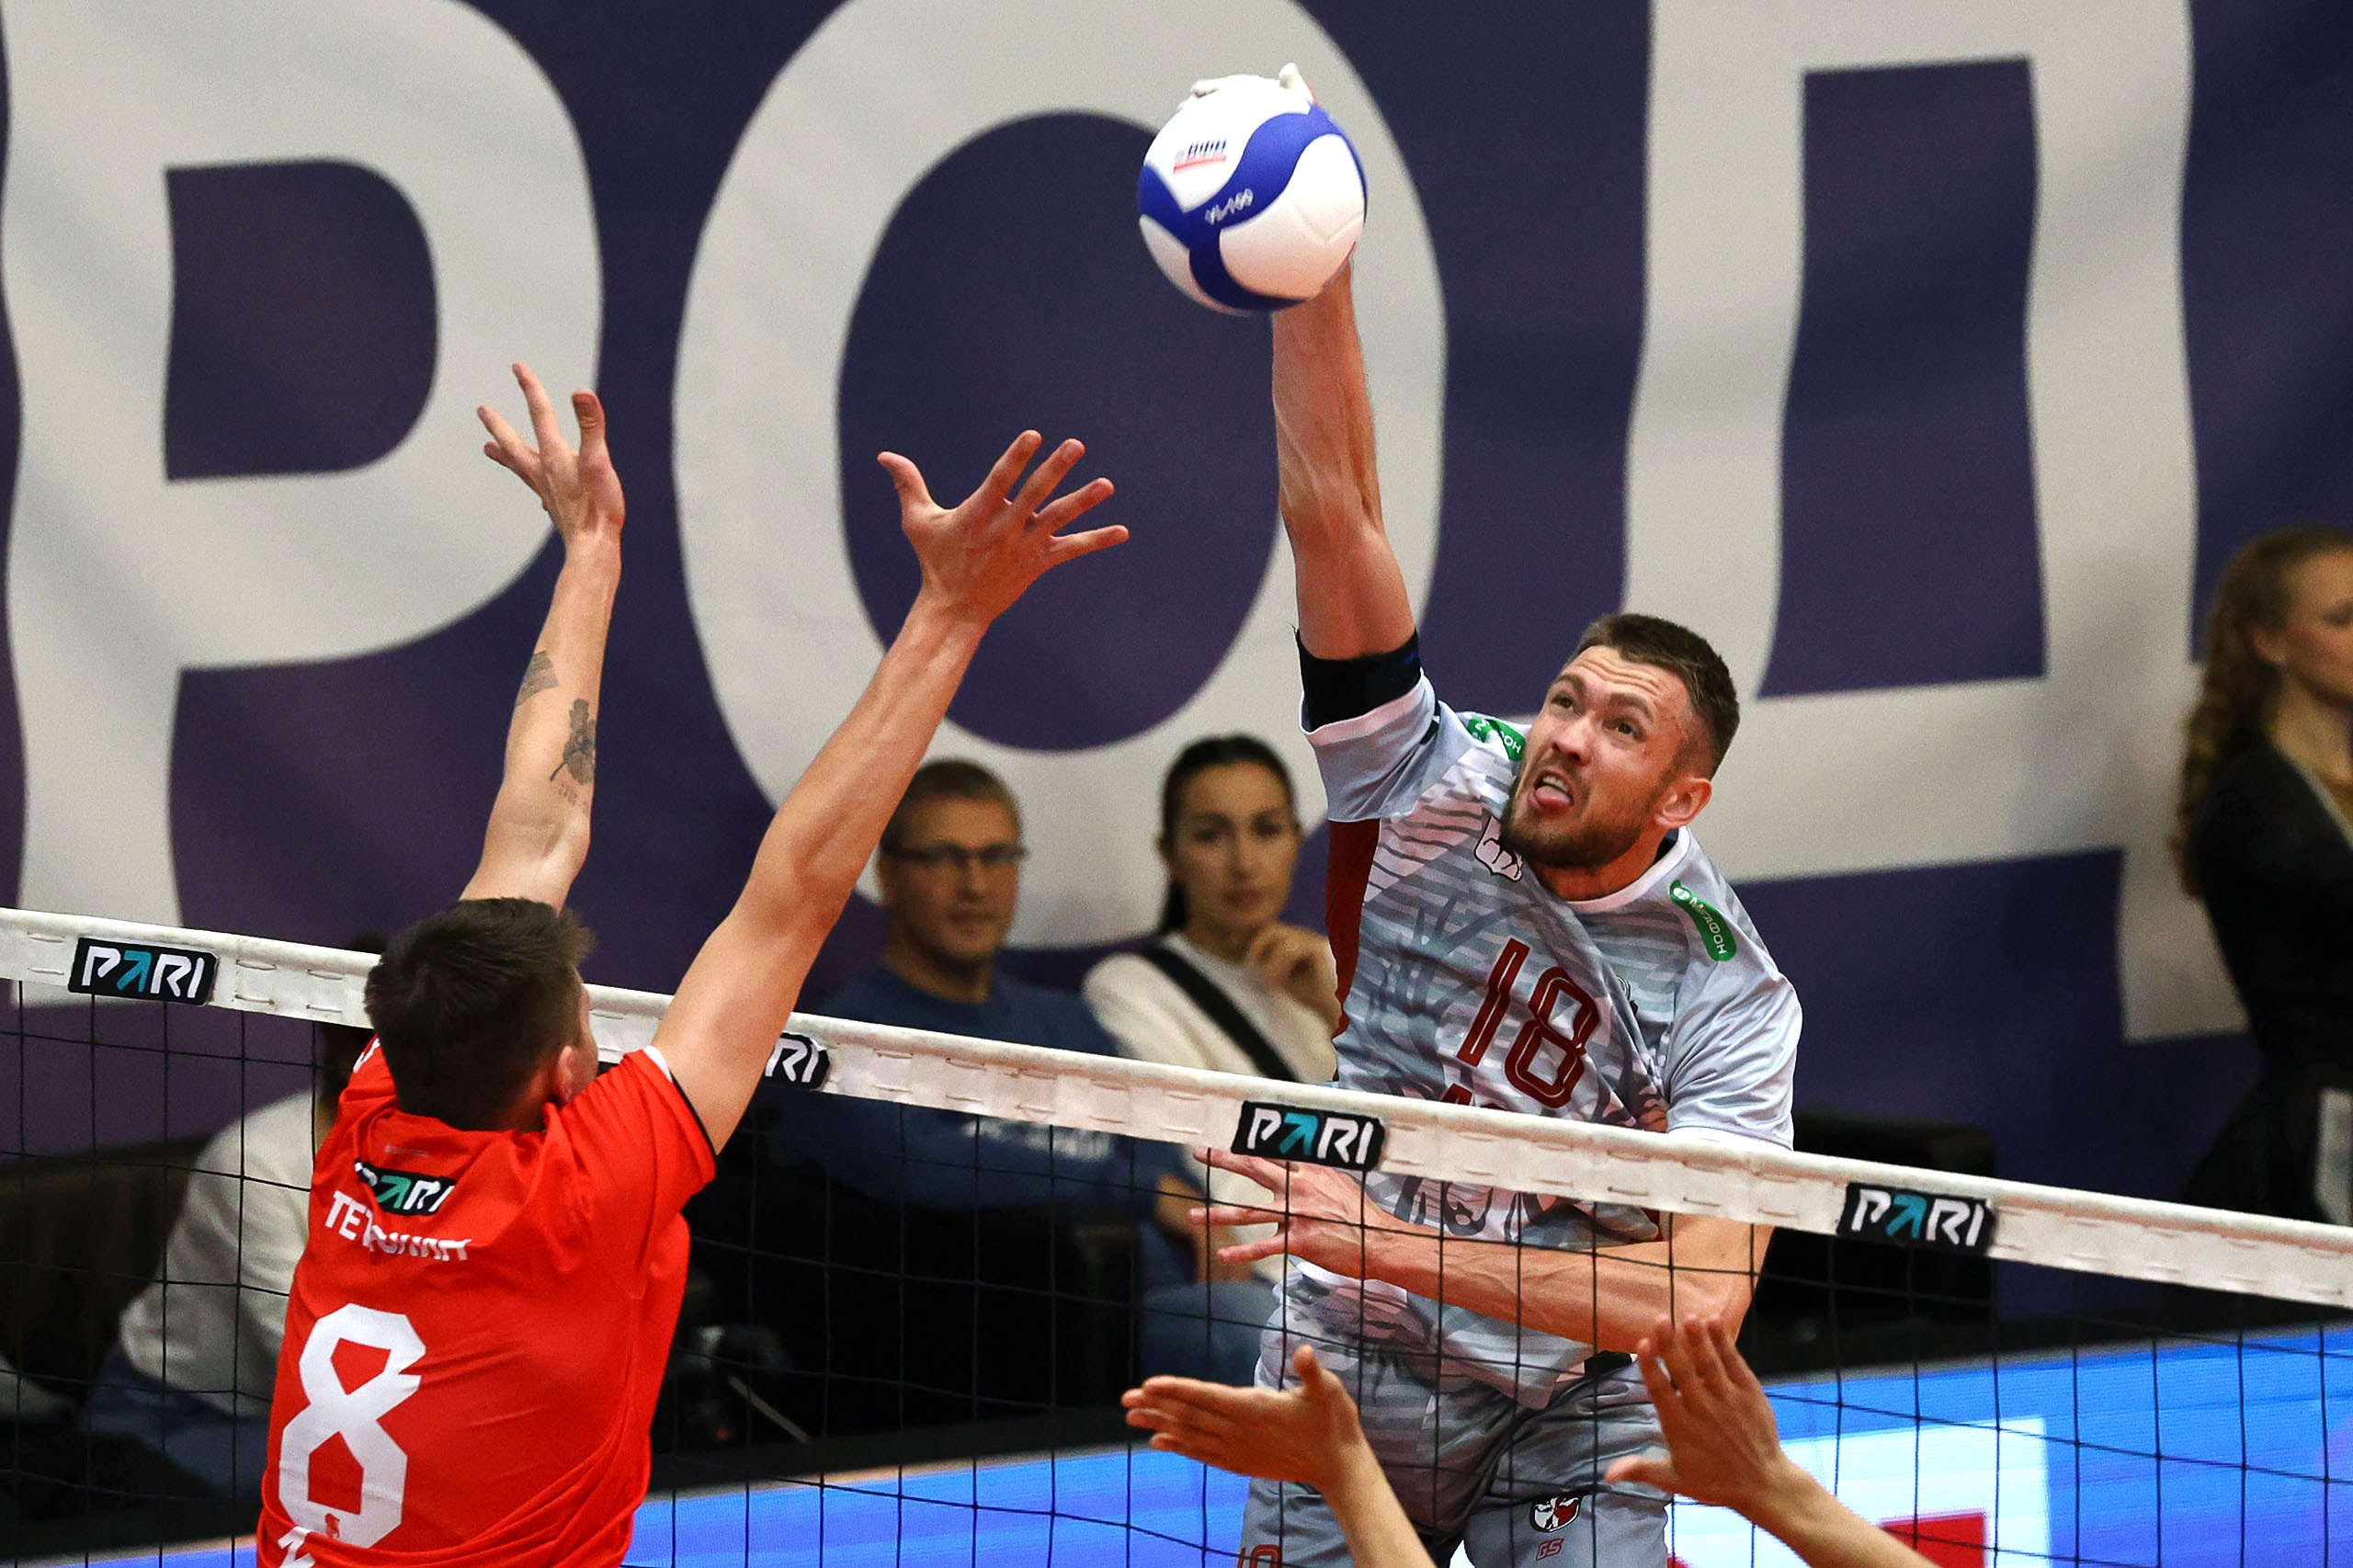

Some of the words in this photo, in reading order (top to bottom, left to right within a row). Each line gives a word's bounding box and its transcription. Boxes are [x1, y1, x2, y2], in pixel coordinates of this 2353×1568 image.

[1689, 896, 1727, 954] МАФОН
[81, 945, 205, 999] PARI
[1457, 937, 1600, 1108] 18
[765, 1038, 819, 1083] RI
[1246, 1107, 1374, 1165] PARI
[1850, 1188, 1984, 1246] PARI
[278, 1302, 426, 1549] 8
